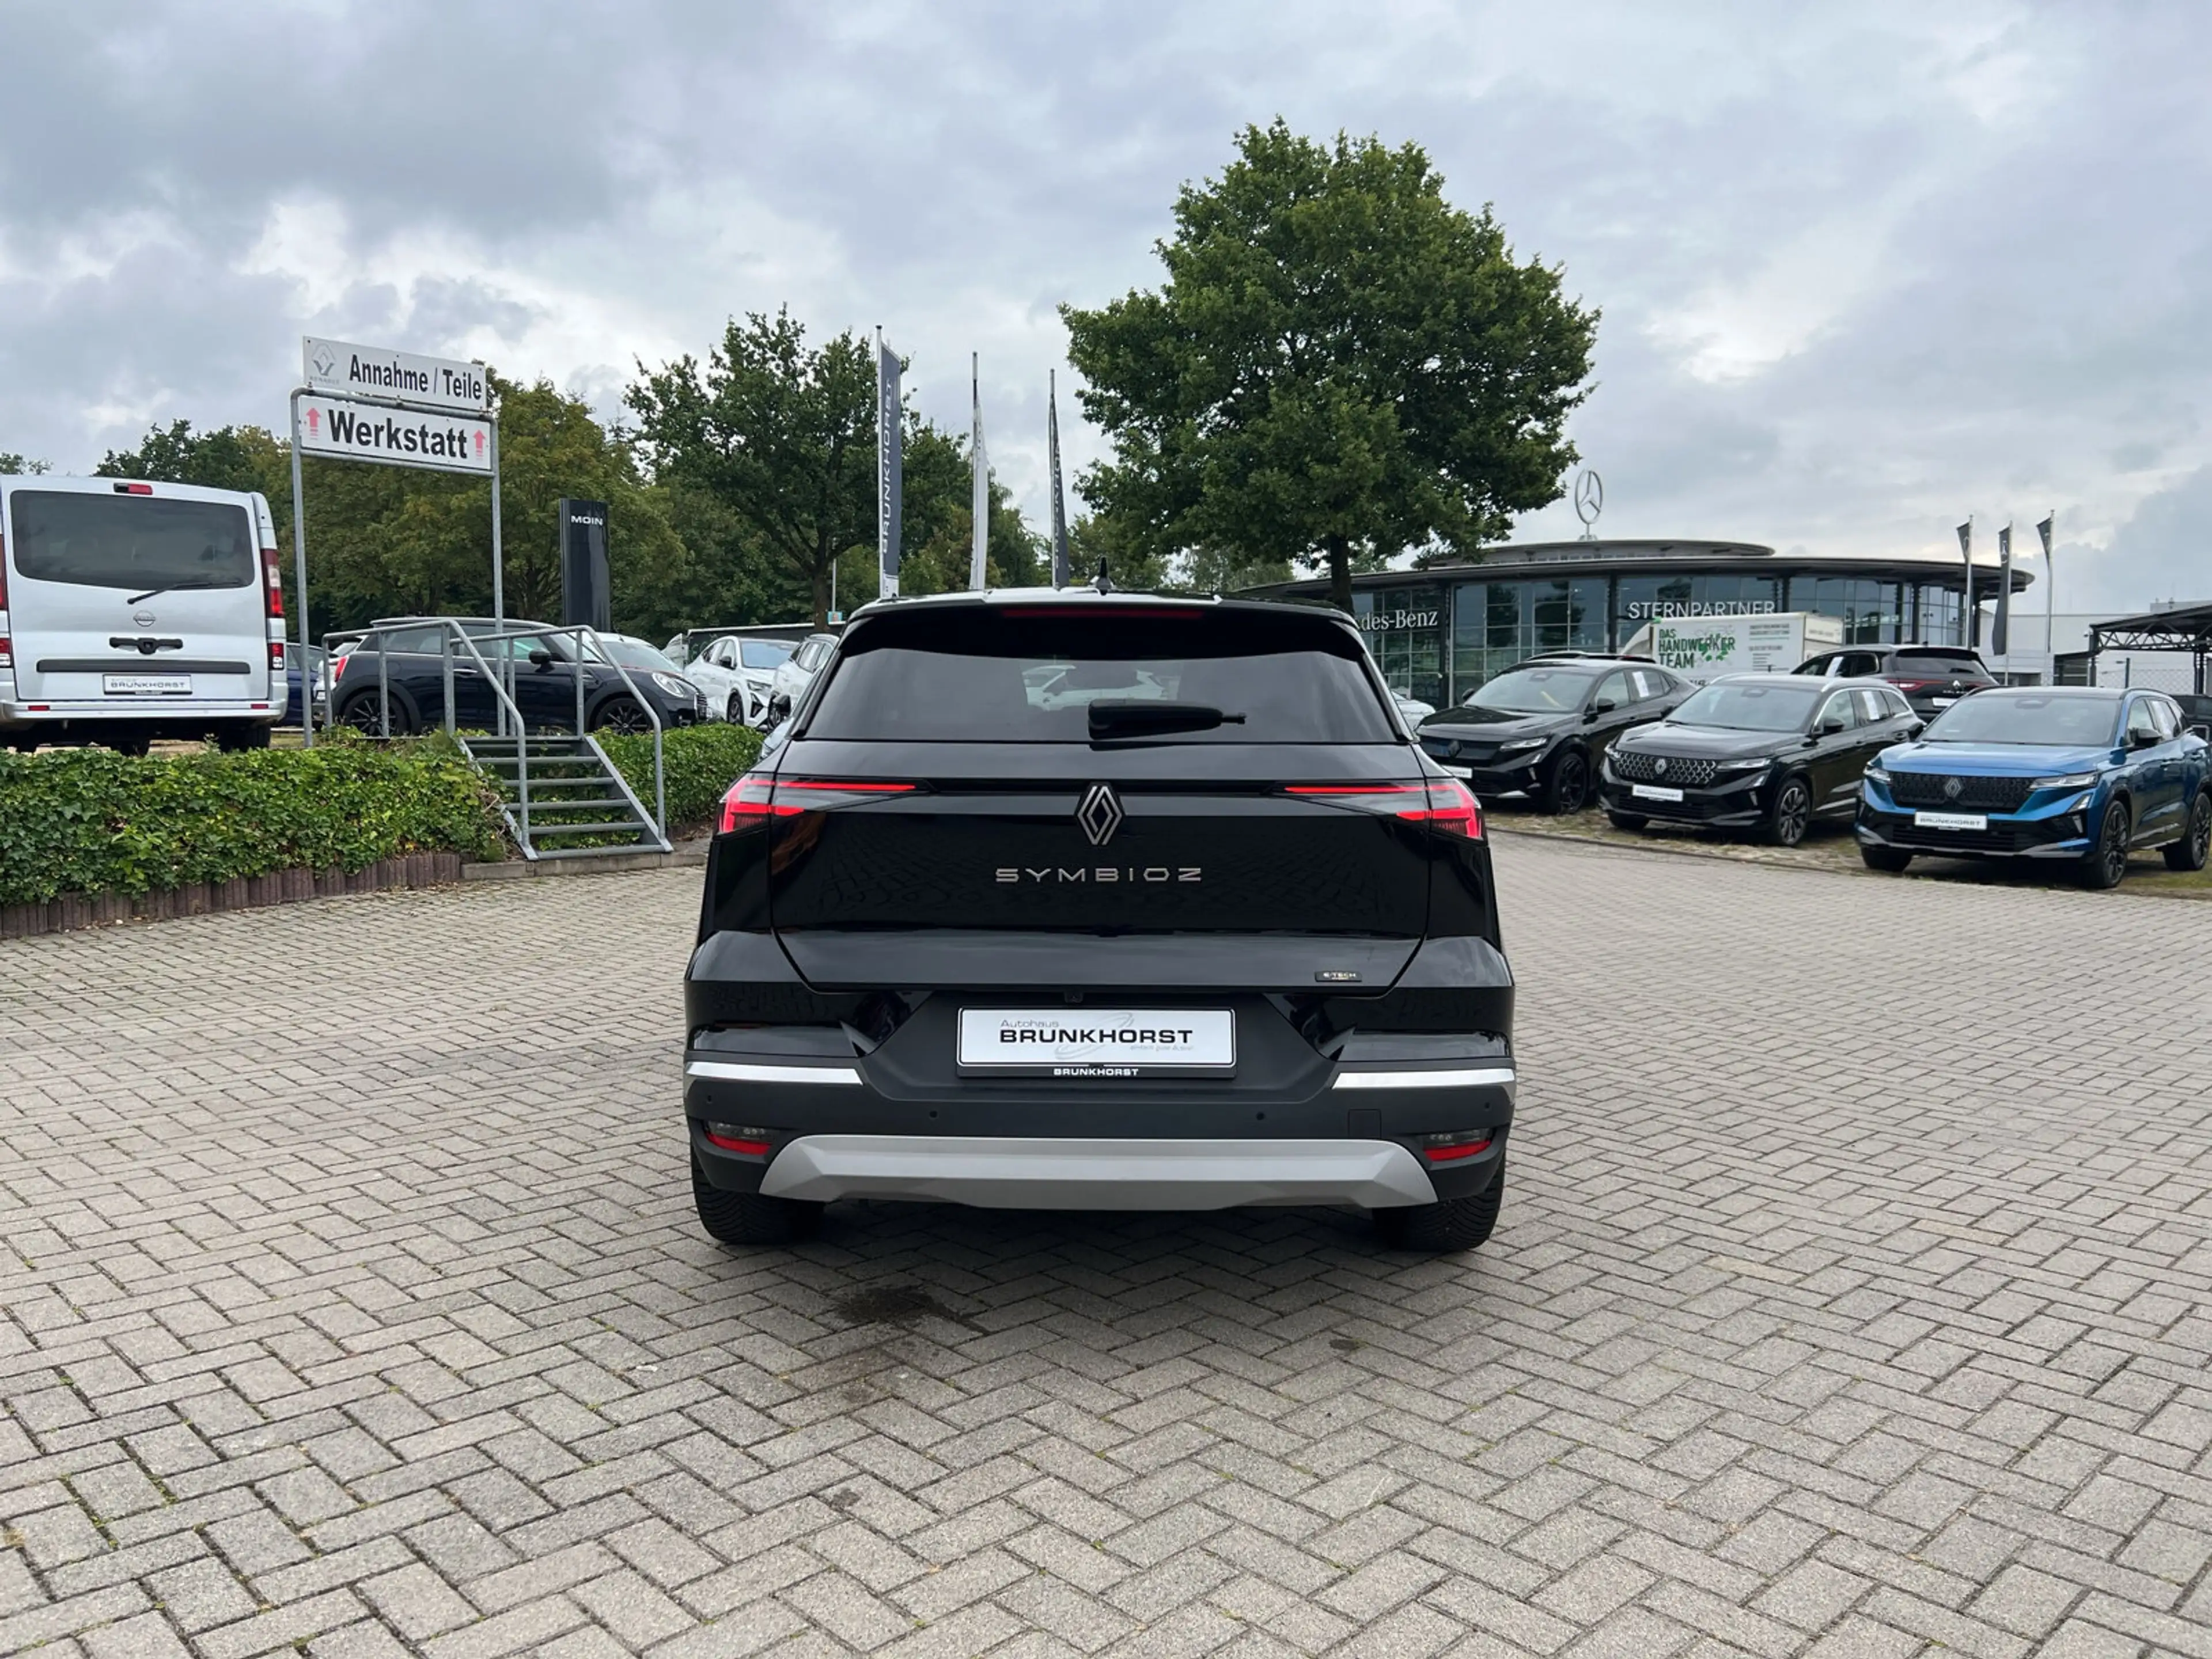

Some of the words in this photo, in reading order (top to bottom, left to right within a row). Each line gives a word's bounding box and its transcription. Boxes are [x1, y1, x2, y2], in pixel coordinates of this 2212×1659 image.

[349, 354, 428, 392] Annahme
[433, 367, 438, 394] /
[442, 369, 482, 400] Teile
[328, 409, 468, 459] Werkstatt
[571, 515, 603, 526] MOIN
[1628, 601, 1775, 619] STERNPARTNER
[1360, 609, 1438, 631] des-Benz
[1658, 628, 1677, 638] DAS
[1658, 636, 1736, 652] HANDWERKER
[1658, 652, 1695, 669] TEAM
[995, 868, 1202, 882] SYMBIOZ
[1000, 1019, 1059, 1028] Autohaus
[999, 1029, 1194, 1044] BRUNKHORST
[1053, 1068, 1139, 1076] BRUNKHORST
